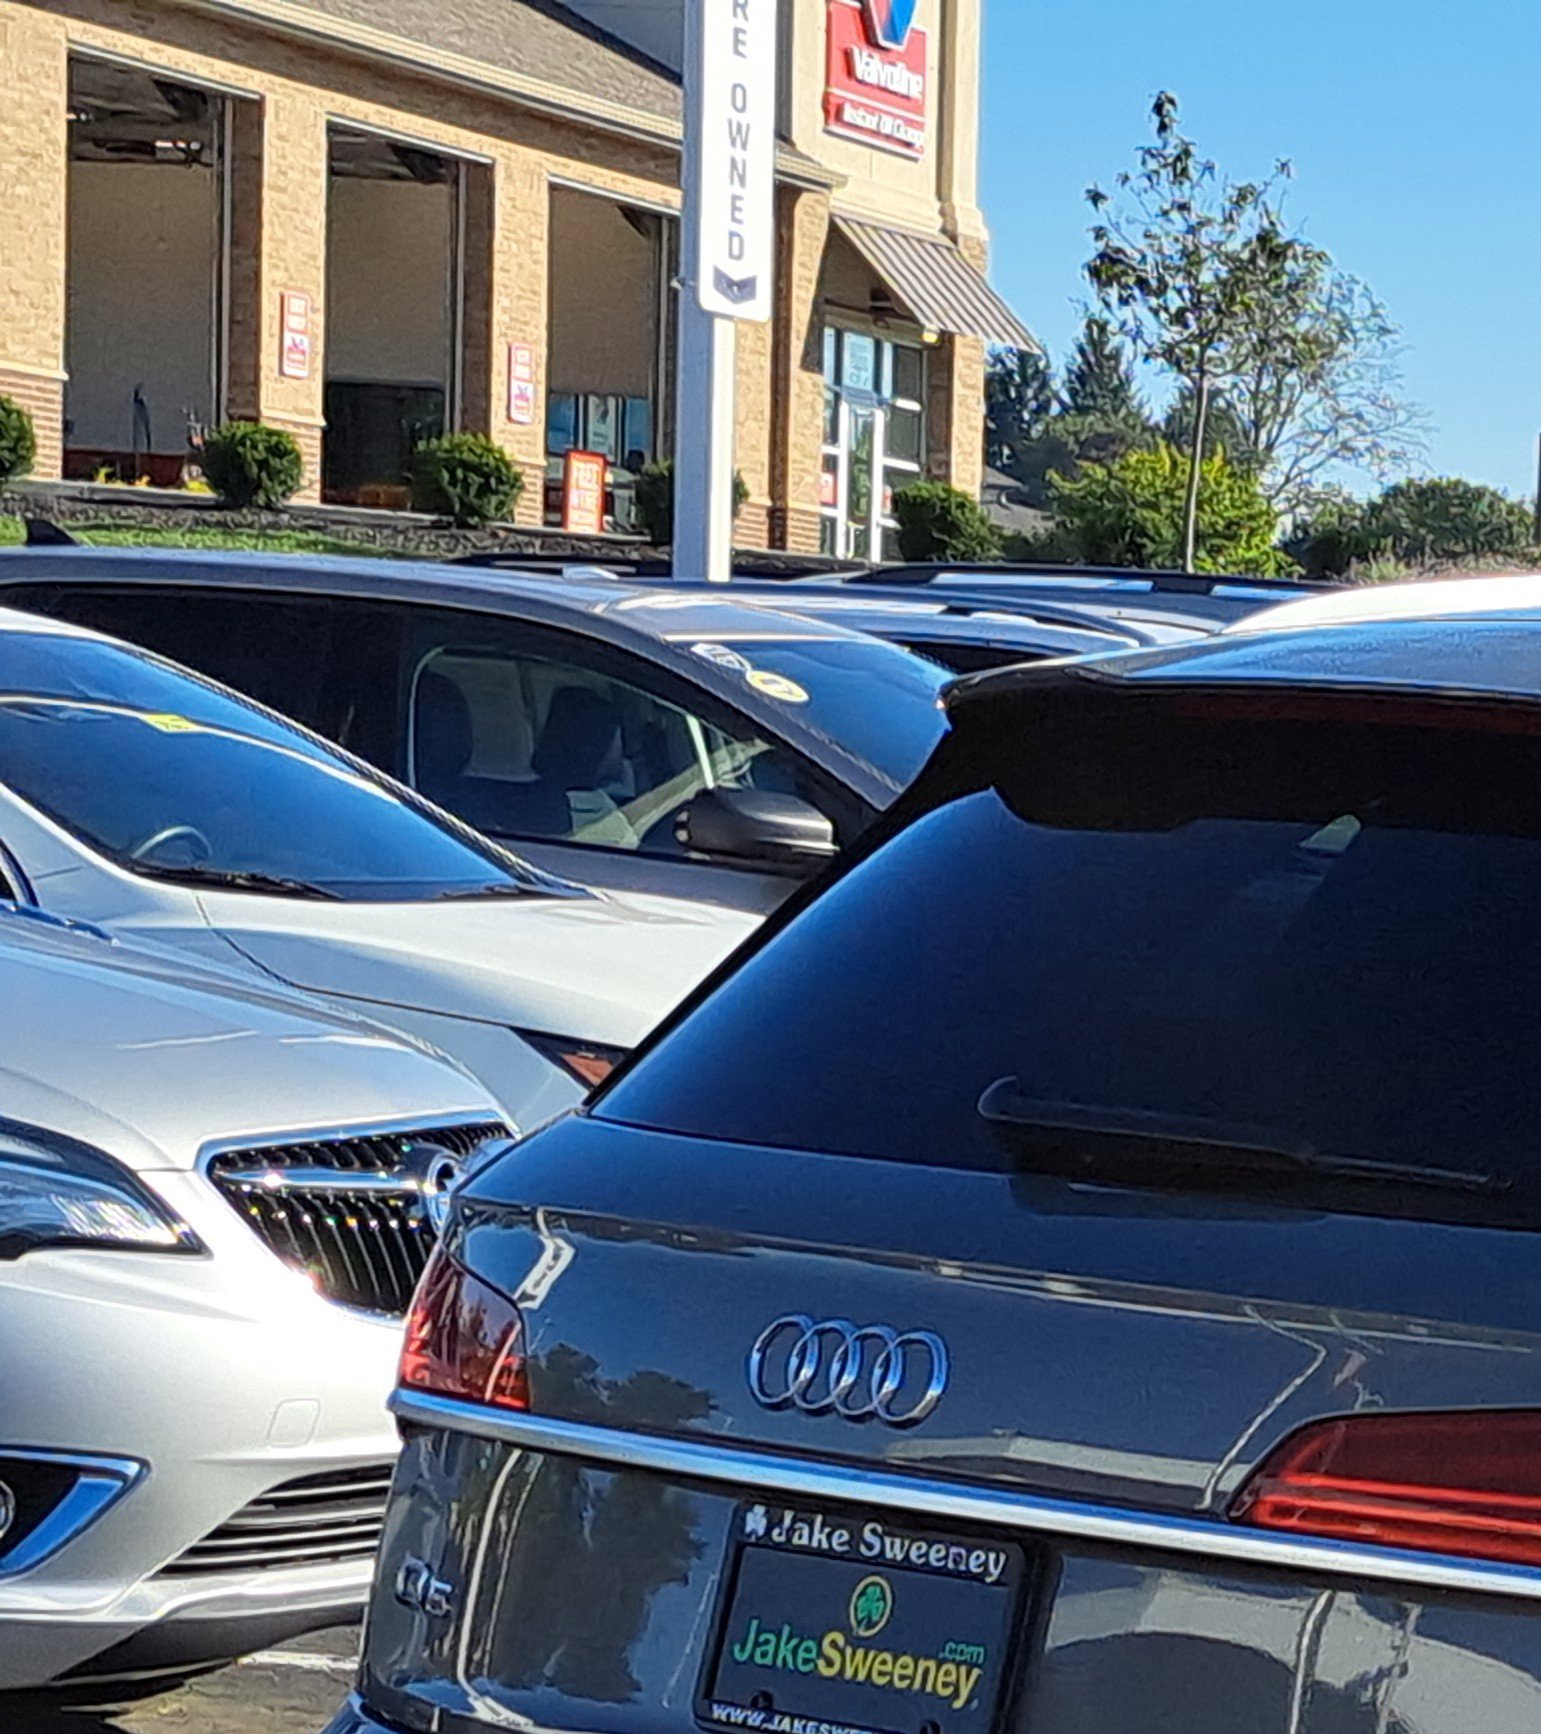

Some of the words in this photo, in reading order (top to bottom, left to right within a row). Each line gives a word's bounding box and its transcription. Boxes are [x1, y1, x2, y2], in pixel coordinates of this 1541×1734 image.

[726, 83, 751, 262] OWNED
[770, 1509, 851, 1552] Jake
[859, 1521, 1008, 1584] Sweeney
